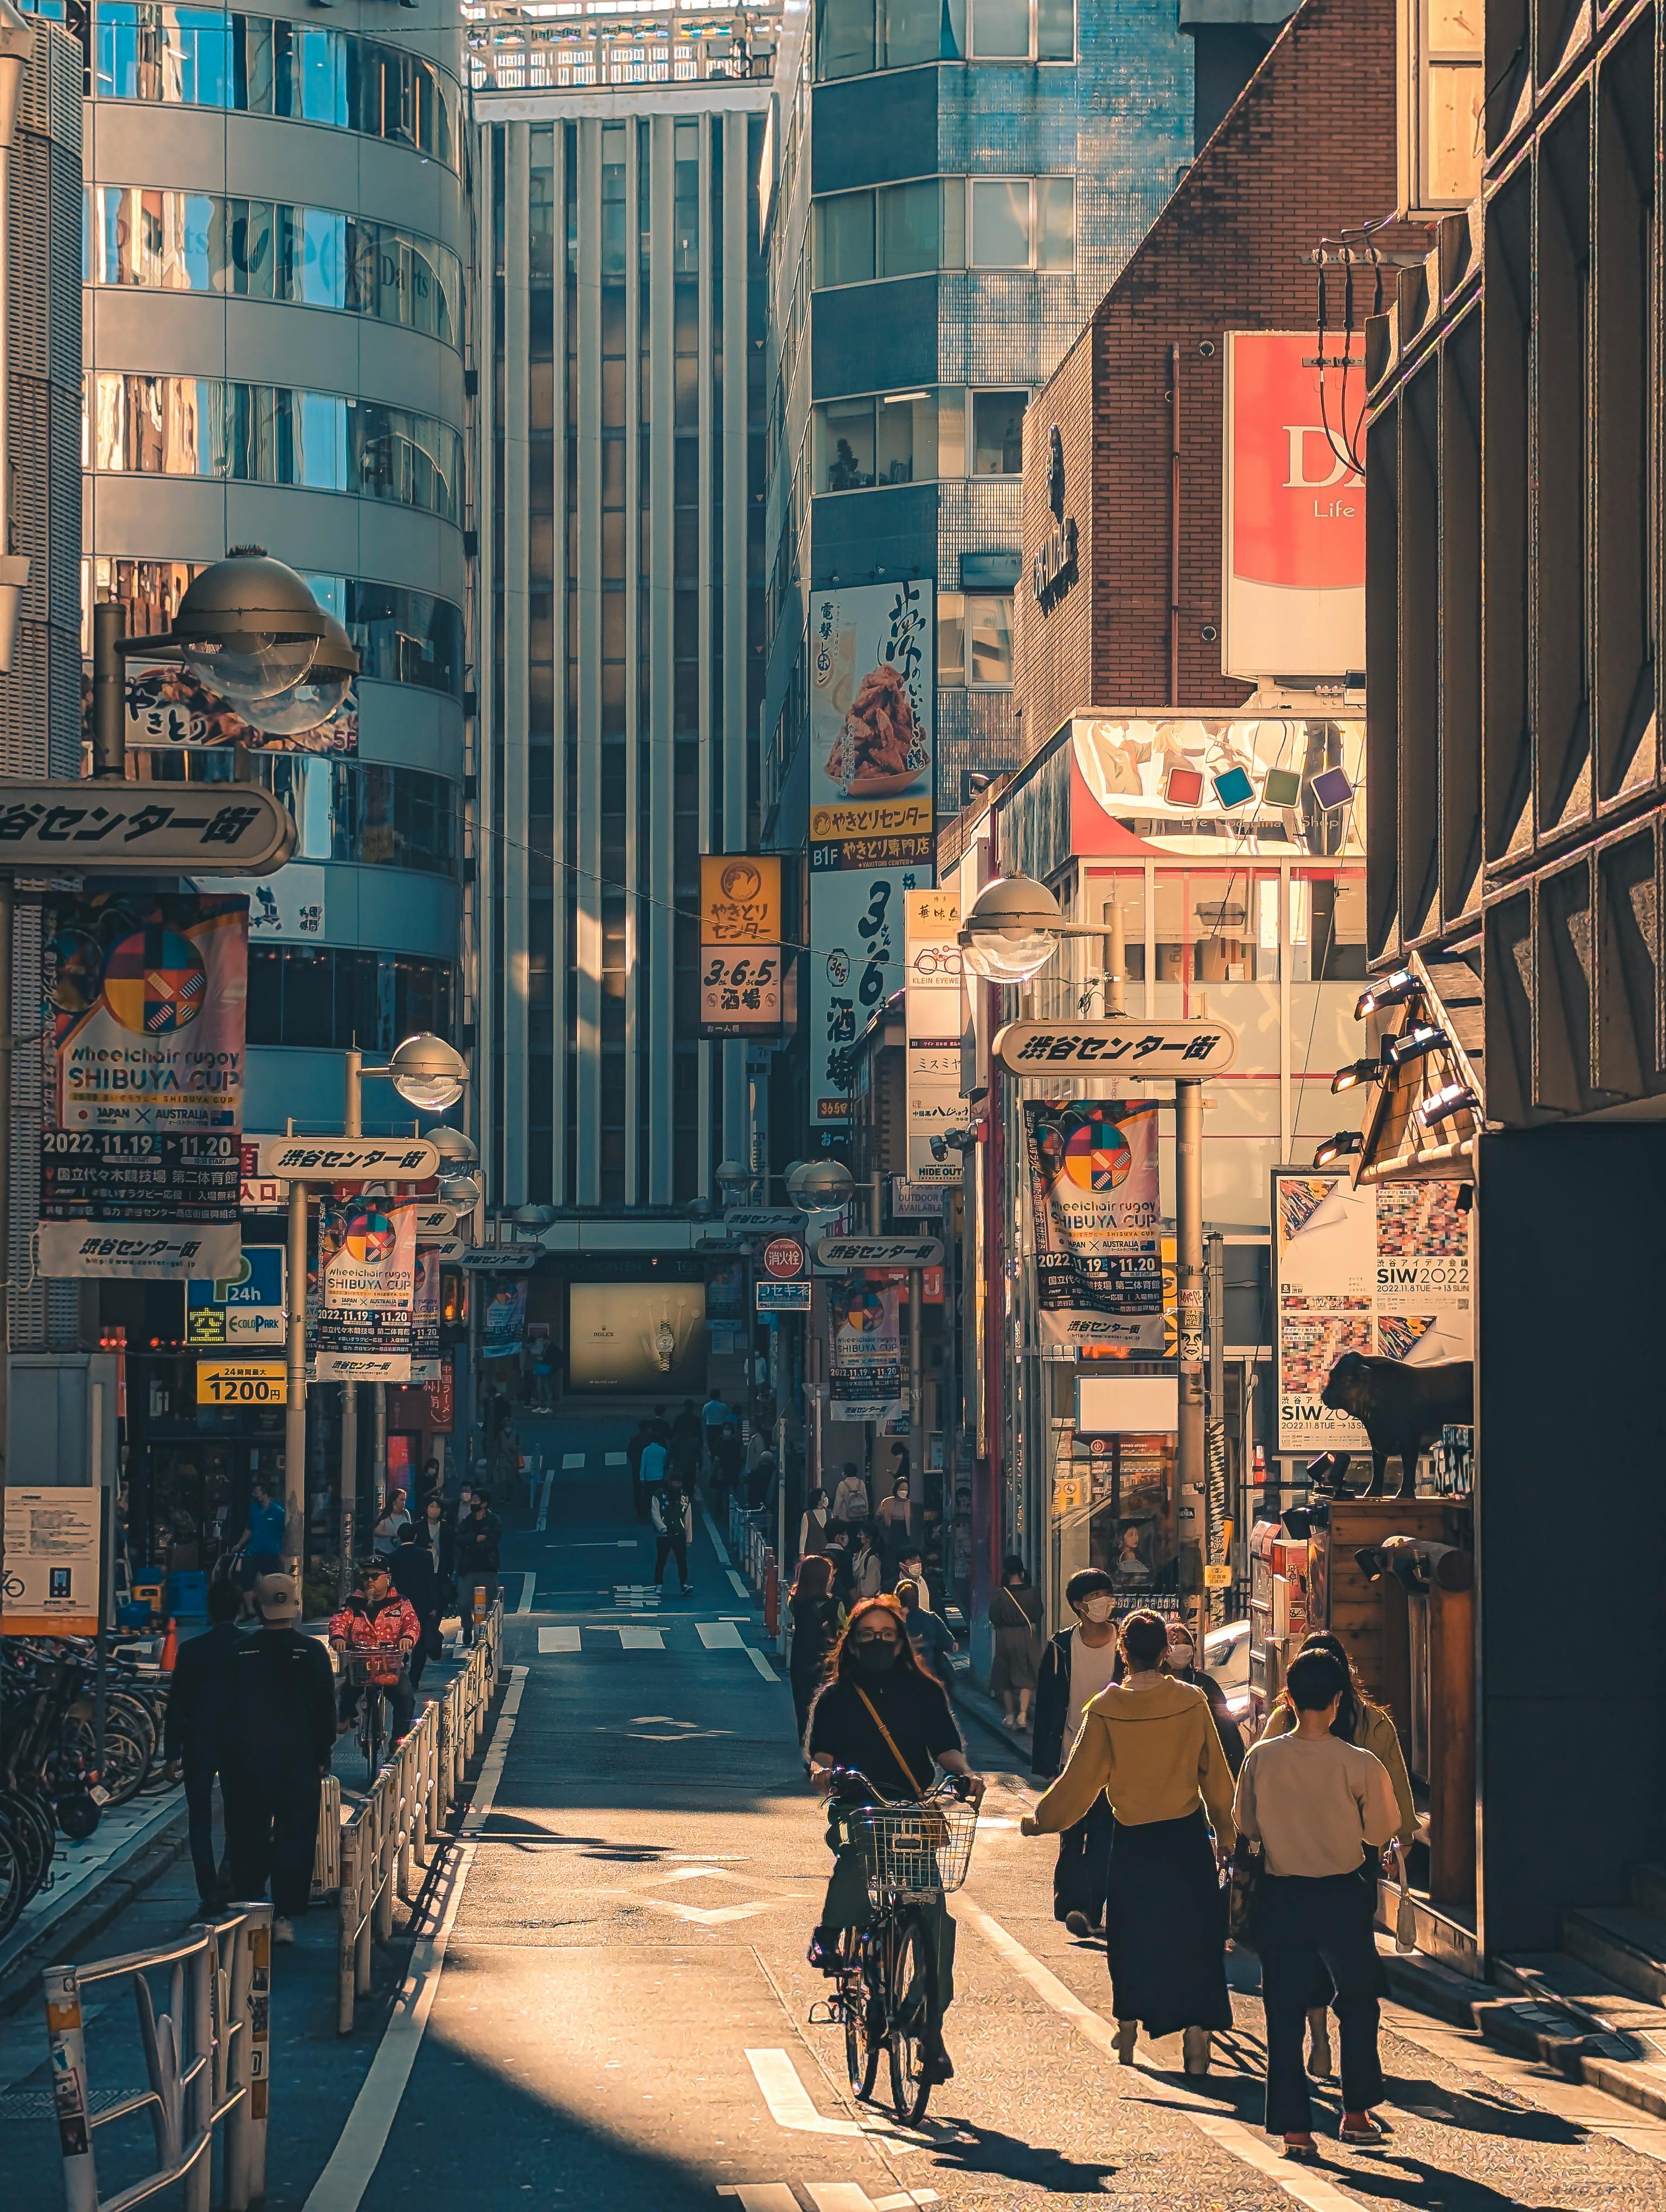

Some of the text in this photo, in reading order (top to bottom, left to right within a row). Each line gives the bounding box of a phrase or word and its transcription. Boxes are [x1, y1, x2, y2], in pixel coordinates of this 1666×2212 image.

[1314, 500, 1355, 517] Life
[332, 730, 357, 751] 5F
[0, 803, 262, 844] 谷センター街
[832, 807, 929, 832] やきとりセンター
[1301, 815, 1339, 830] Shop
[813, 845, 838, 866] B1F
[843, 837, 930, 860] やきとり専門店
[711, 903, 768, 921] やきとり
[713, 922, 771, 939] センター
[721, 987, 761, 1010] 酒場
[1017, 1035, 1221, 1061] 渋谷センター街
[68, 1066, 240, 1092] SHIBUYA CUP
[163, 1095, 233, 1104] SHIBUYA CUP
[97, 1107, 209, 1120] JAPAN AUSTRALIA
[43, 1133, 152, 1155] 2022.11.19
[180, 1136, 232, 1156] 11.20
[278, 1149, 428, 1169] 渋谷センター街
[58, 1167, 238, 1185] 国立代々木競技場 第二体育館
[919, 1168, 962, 1176] HIDE OUT
[197, 1190, 236, 1201] 入場無料
[898, 1193, 939, 1202] OUTDOOR
[898, 1203, 942, 1212] AVAILABLE
[1050, 1212, 1156, 1229] SHIBUYA CUP
[79, 1237, 202, 1259] 渋谷センター街
[827, 1245, 935, 1259] 渋谷センター街
[1102, 1240, 1139, 1248] AUSTRALIA
[769, 1251, 800, 1266] 消火栓
[1038, 1253, 1101, 1272] 2022.11.19
[1119, 1258, 1155, 1271] 11.20
[1377, 1258, 1469, 1268] 渋谷アイデア会議
[328, 1278, 411, 1290] SHIBUYA CUP
[1116, 1281, 1160, 1290] 第二体育館
[229, 1287, 260, 1301] 24h
[318, 1309, 368, 1320] 2022.11.19
[381, 1311, 407, 1322] 11.20
[190, 1307, 225, 1342] 空
[1067, 1320, 1142, 1334] 渋谷センター街
[838, 1344, 876, 1353] SHIBUYA
[879, 1344, 898, 1353] CUP
[224, 1368, 266, 1376] 24時間最大
[331, 1360, 392, 1371] 渋谷センター街
[877, 1367, 896, 1375] 11.20
[210, 1381, 280, 1401] 1200円
[441, 1365, 452, 1423] 中国ラーメン
